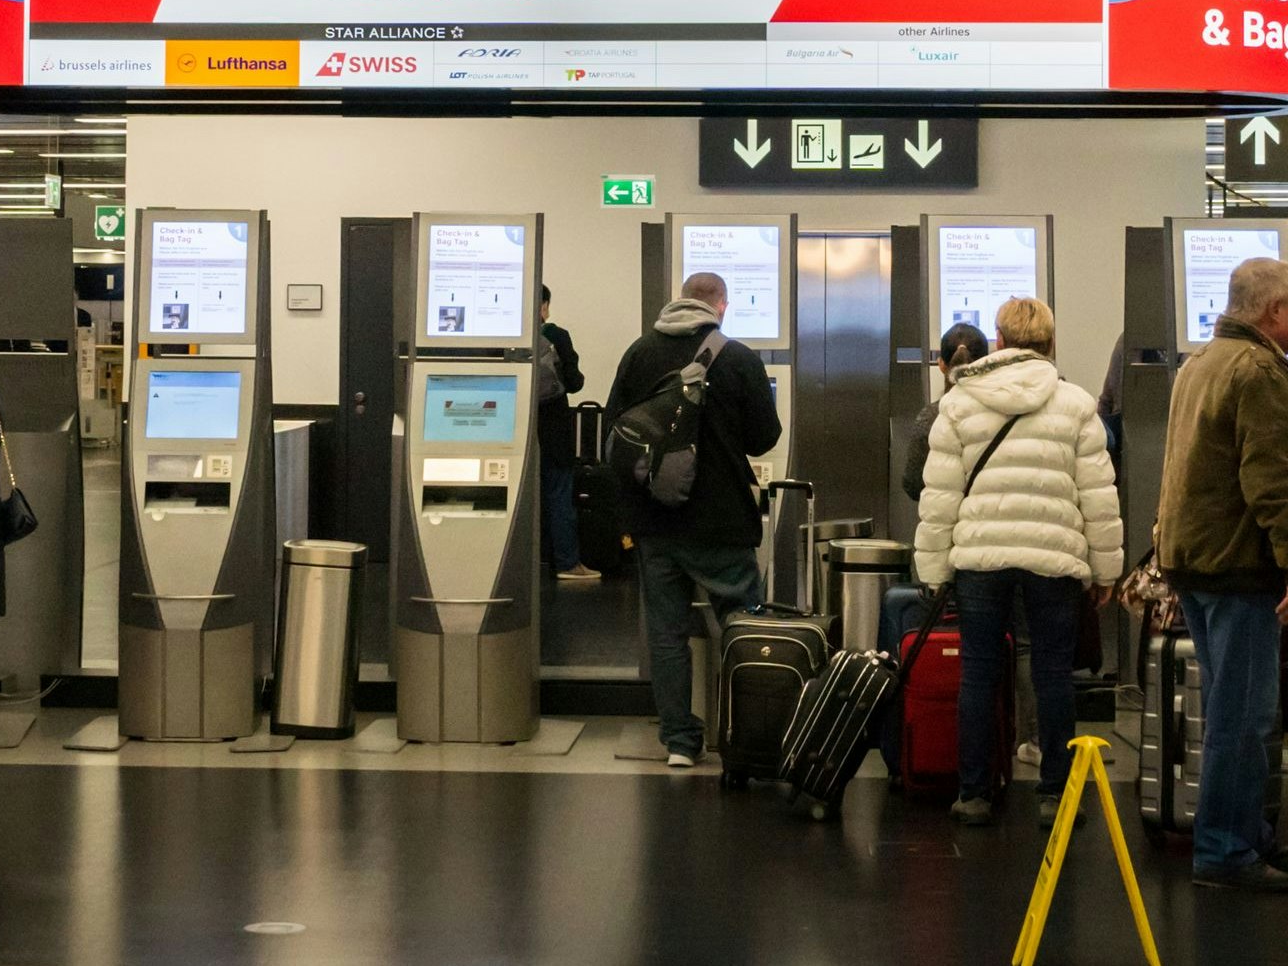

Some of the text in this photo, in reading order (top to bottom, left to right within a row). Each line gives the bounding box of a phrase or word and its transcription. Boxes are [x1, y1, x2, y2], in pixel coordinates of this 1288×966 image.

[324, 27, 446, 39] STAR ALLIANCE
[898, 27, 970, 37] other Airlines
[1202, 8, 1231, 46] &
[786, 49, 825, 58] Bulgaria
[919, 51, 959, 61] Luxair
[59, 59, 152, 71] brussels airlines
[208, 57, 287, 70] Lufthansa
[349, 56, 417, 73] SWISS
